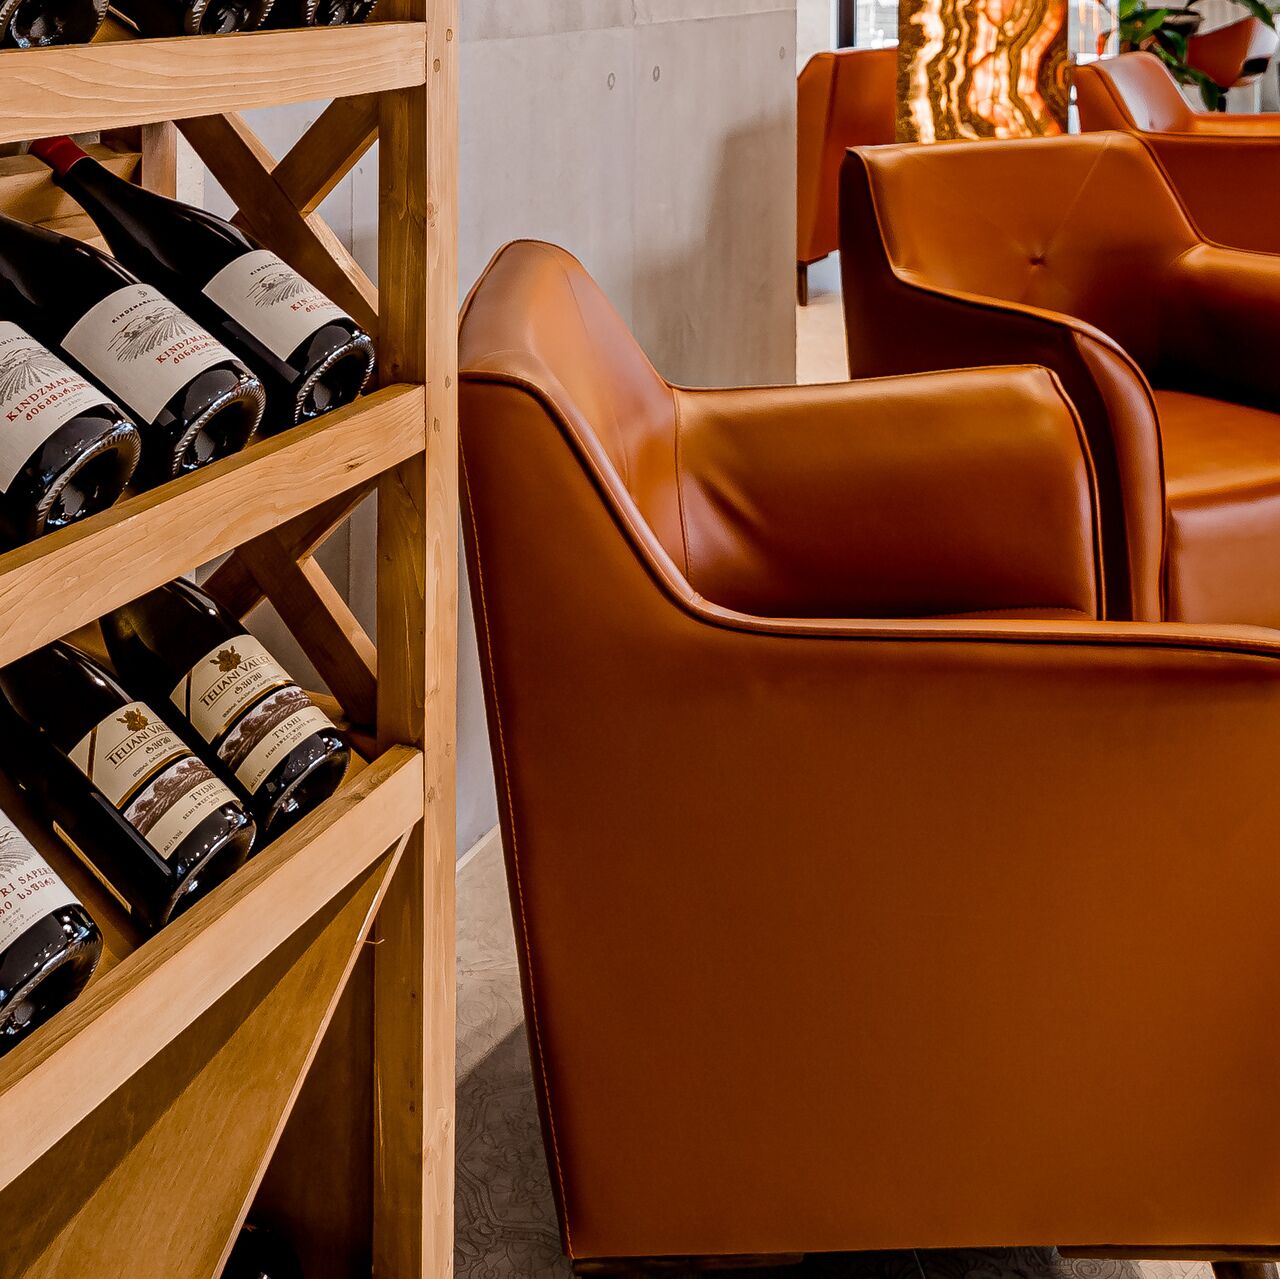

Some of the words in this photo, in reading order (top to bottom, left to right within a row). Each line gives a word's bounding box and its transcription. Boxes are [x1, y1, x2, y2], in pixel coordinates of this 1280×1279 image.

[199, 669, 241, 707] TELIANI
[239, 655, 271, 673] VALLEY
[271, 716, 302, 739] TVISHI
[106, 730, 151, 765] TELIANI
[189, 782, 217, 801] TVISHI
